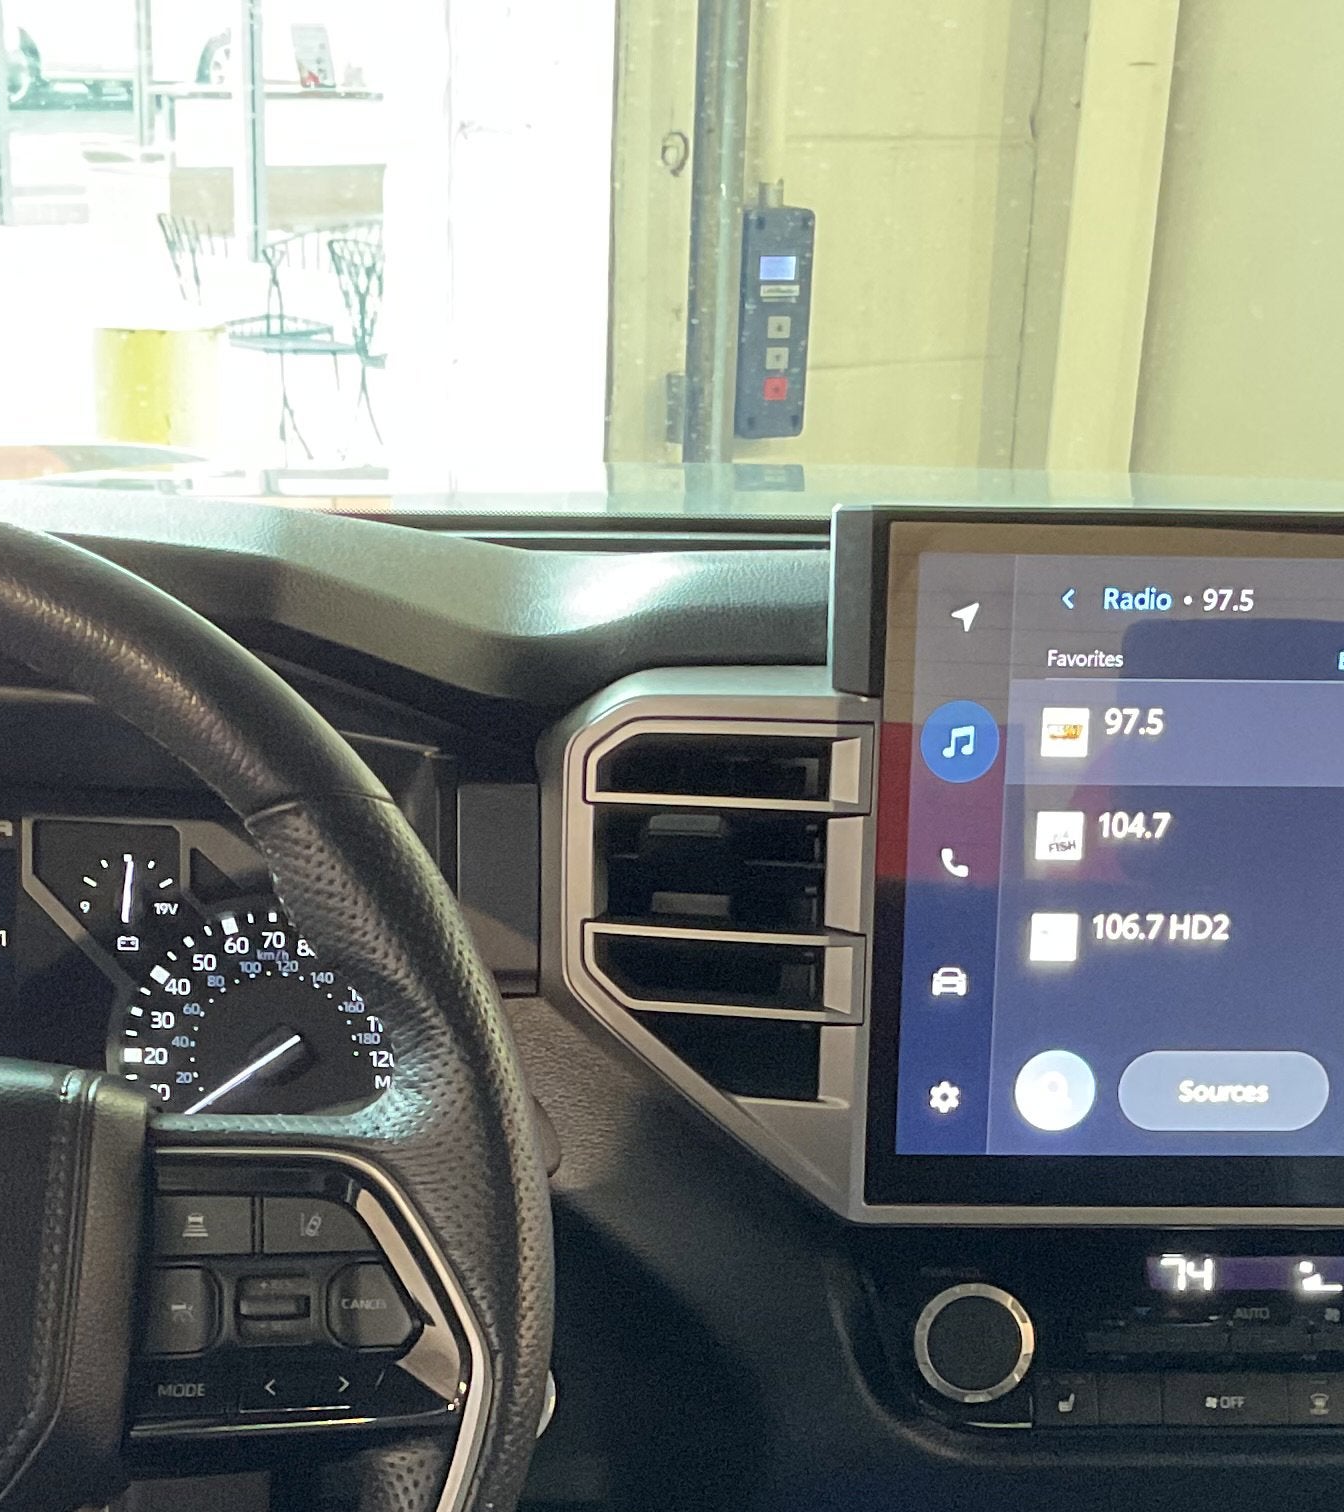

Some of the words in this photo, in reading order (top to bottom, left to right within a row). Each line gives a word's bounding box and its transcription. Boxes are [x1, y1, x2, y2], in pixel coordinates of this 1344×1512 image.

[1103, 587, 1173, 612] Radio
[1202, 588, 1255, 613] 97.5
[1047, 649, 1124, 669] Favorites
[1104, 707, 1165, 736] 97.5
[1098, 810, 1172, 840] 104.7
[154, 902, 179, 917] 19V
[1092, 914, 1164, 942] 106.7
[1169, 914, 1231, 942] HD2
[224, 936, 249, 955] 60
[261, 930, 286, 949] 70
[192, 953, 217, 972] 50
[256, 950, 290, 962] km/h
[239, 962, 262, 974] 100
[276, 960, 299, 973] 120
[207, 975, 225, 988] 80
[310, 971, 334, 985] 140
[164, 977, 191, 996] 40
[183, 1003, 200, 1015] 60
[343, 1002, 365, 1014] 160
[150, 1010, 175, 1030] 30
[171, 1036, 189, 1047] 40
[356, 1033, 381, 1045] 180
[143, 1047, 168, 1065] 20
[175, 1072, 192, 1084] 20
[1178, 1079, 1270, 1104] Sources
[1160, 1257, 1214, 1291] 74
[1233, 1306, 1270, 1320] AUTO
[158, 1382, 206, 1397] MODE
[1219, 1395, 1246, 1409] OFF
